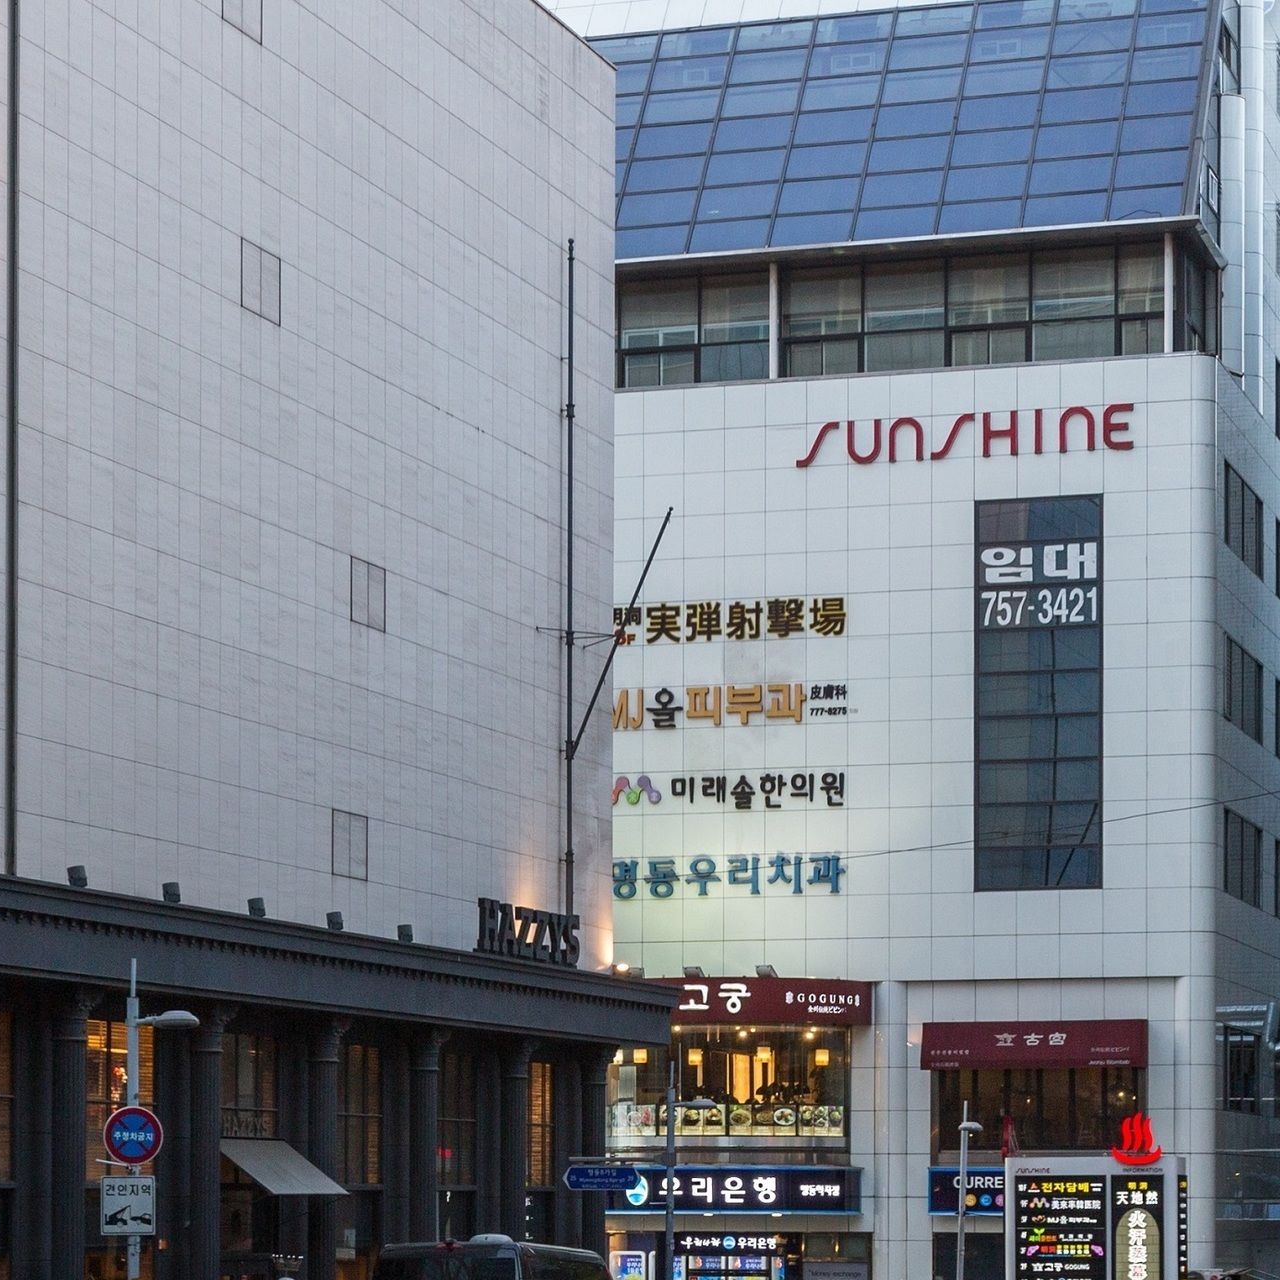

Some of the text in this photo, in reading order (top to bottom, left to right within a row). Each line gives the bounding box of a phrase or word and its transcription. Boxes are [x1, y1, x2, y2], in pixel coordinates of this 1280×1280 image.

[796, 402, 1134, 468] SUNSHINE
[980, 541, 1098, 585] 임대
[981, 586, 1098, 628] 757-3421
[671, 772, 845, 810] 미래솔한의원
[612, 854, 846, 900] 명동우리치과
[477, 897, 580, 968] HAZZYS
[679, 982, 752, 1014] 고궁
[797, 992, 854, 1006] GOGUNG
[113, 1131, 154, 1141] 주정차금지
[105, 1183, 151, 1196] 견인지역
[1041, 1182, 1090, 1193] 전자담배
[1116, 1191, 1158, 1205] 天地然
[737, 1236, 777, 1250] 우리은행
[1064, 1263, 1090, 1271] GOGUNG
